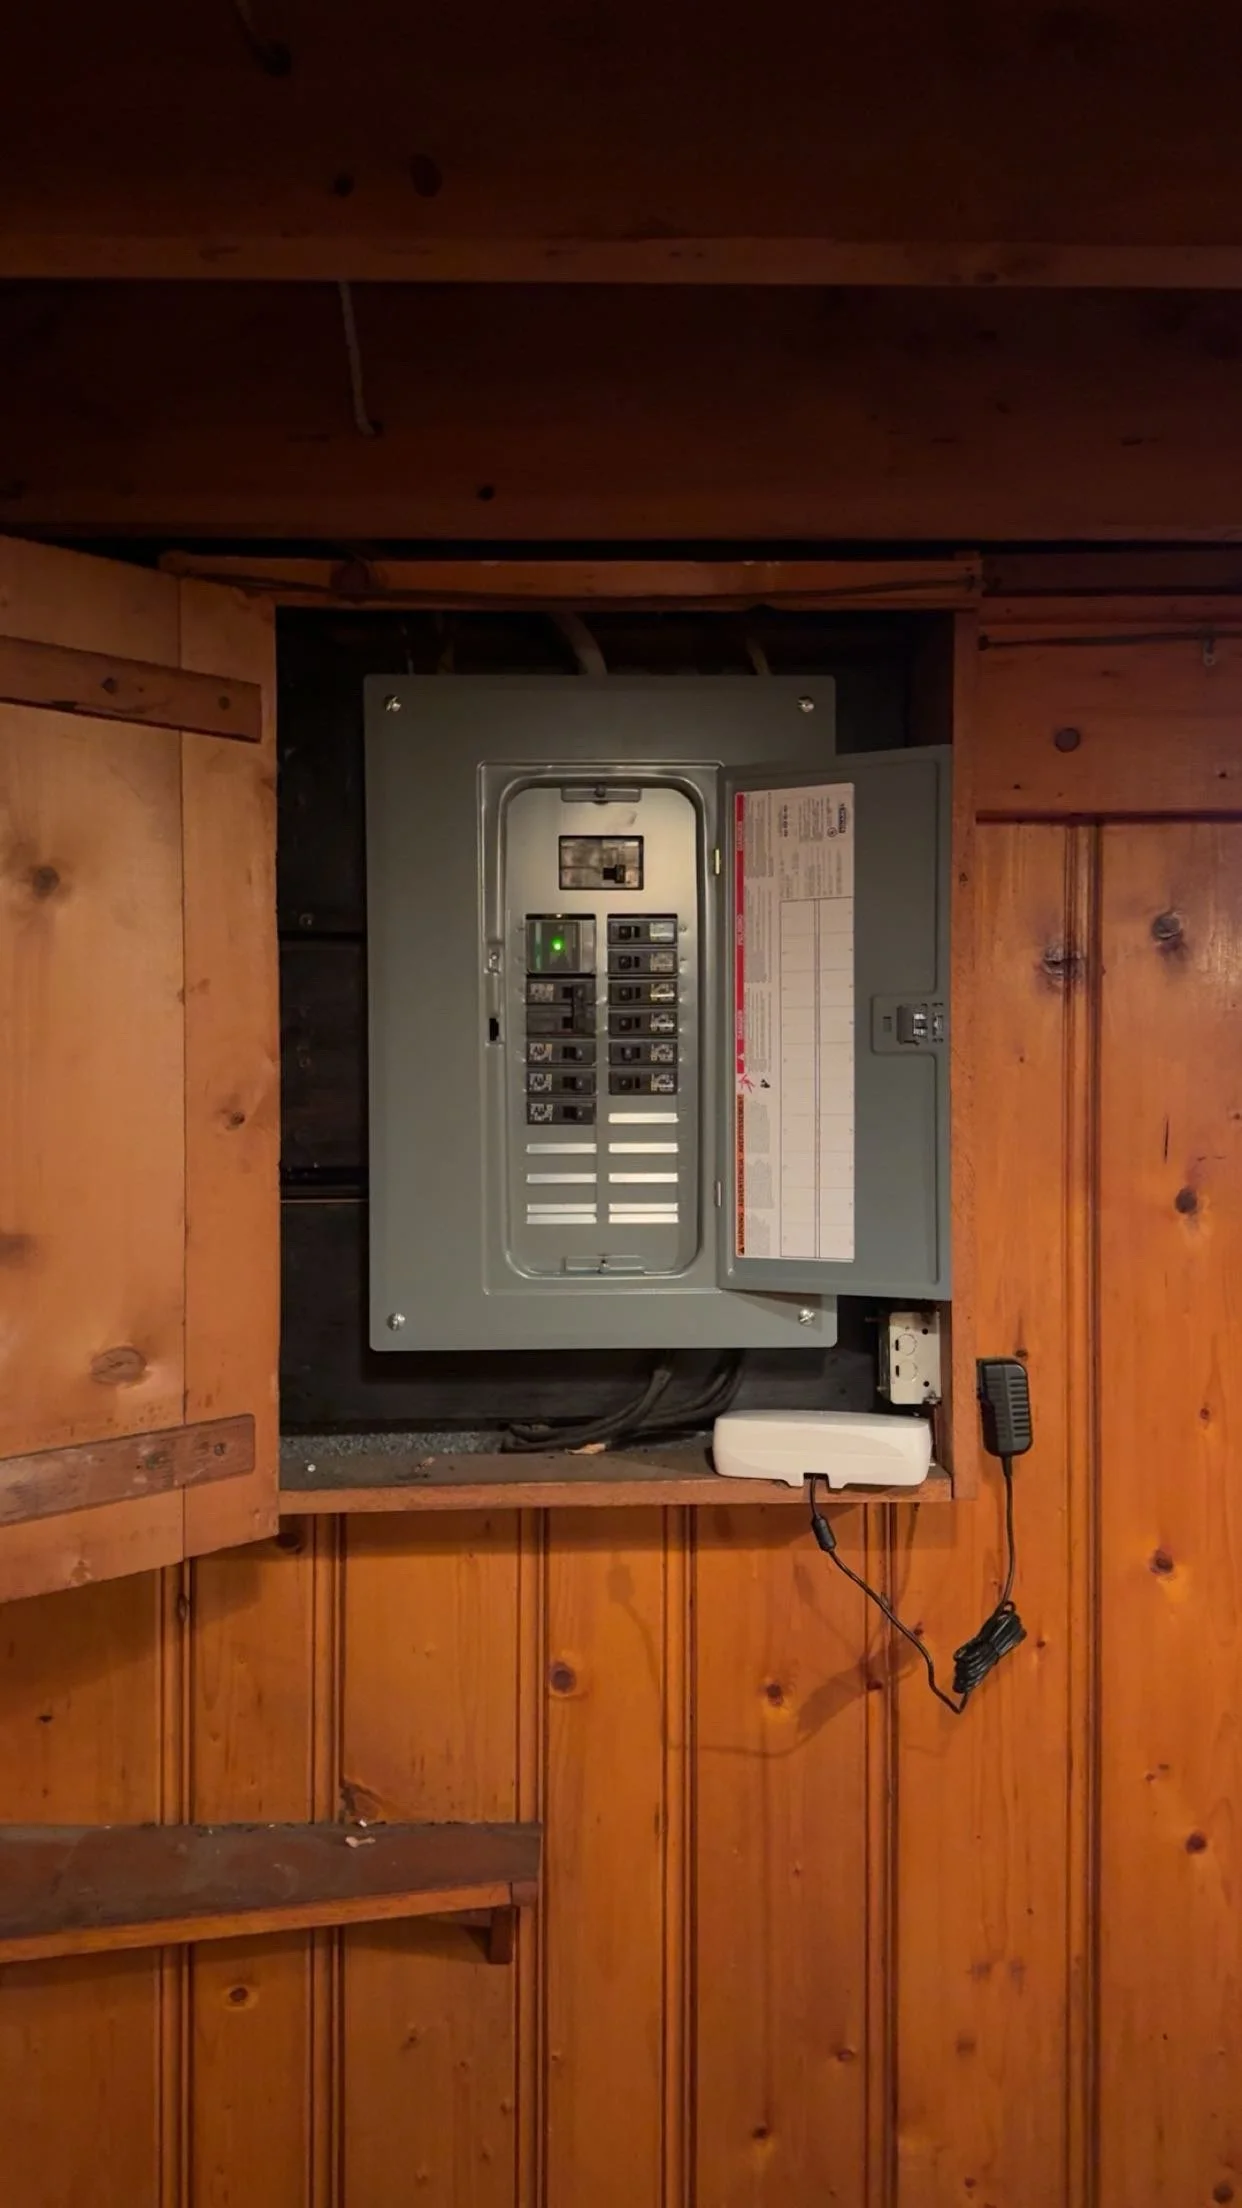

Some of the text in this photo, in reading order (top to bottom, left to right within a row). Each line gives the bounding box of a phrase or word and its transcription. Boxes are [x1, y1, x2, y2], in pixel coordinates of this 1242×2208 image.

[737, 1009, 745, 1040] DANGER
[736, 1095, 744, 1153] AVERTISSEMENT
[737, 1213, 745, 1246] WARNING
